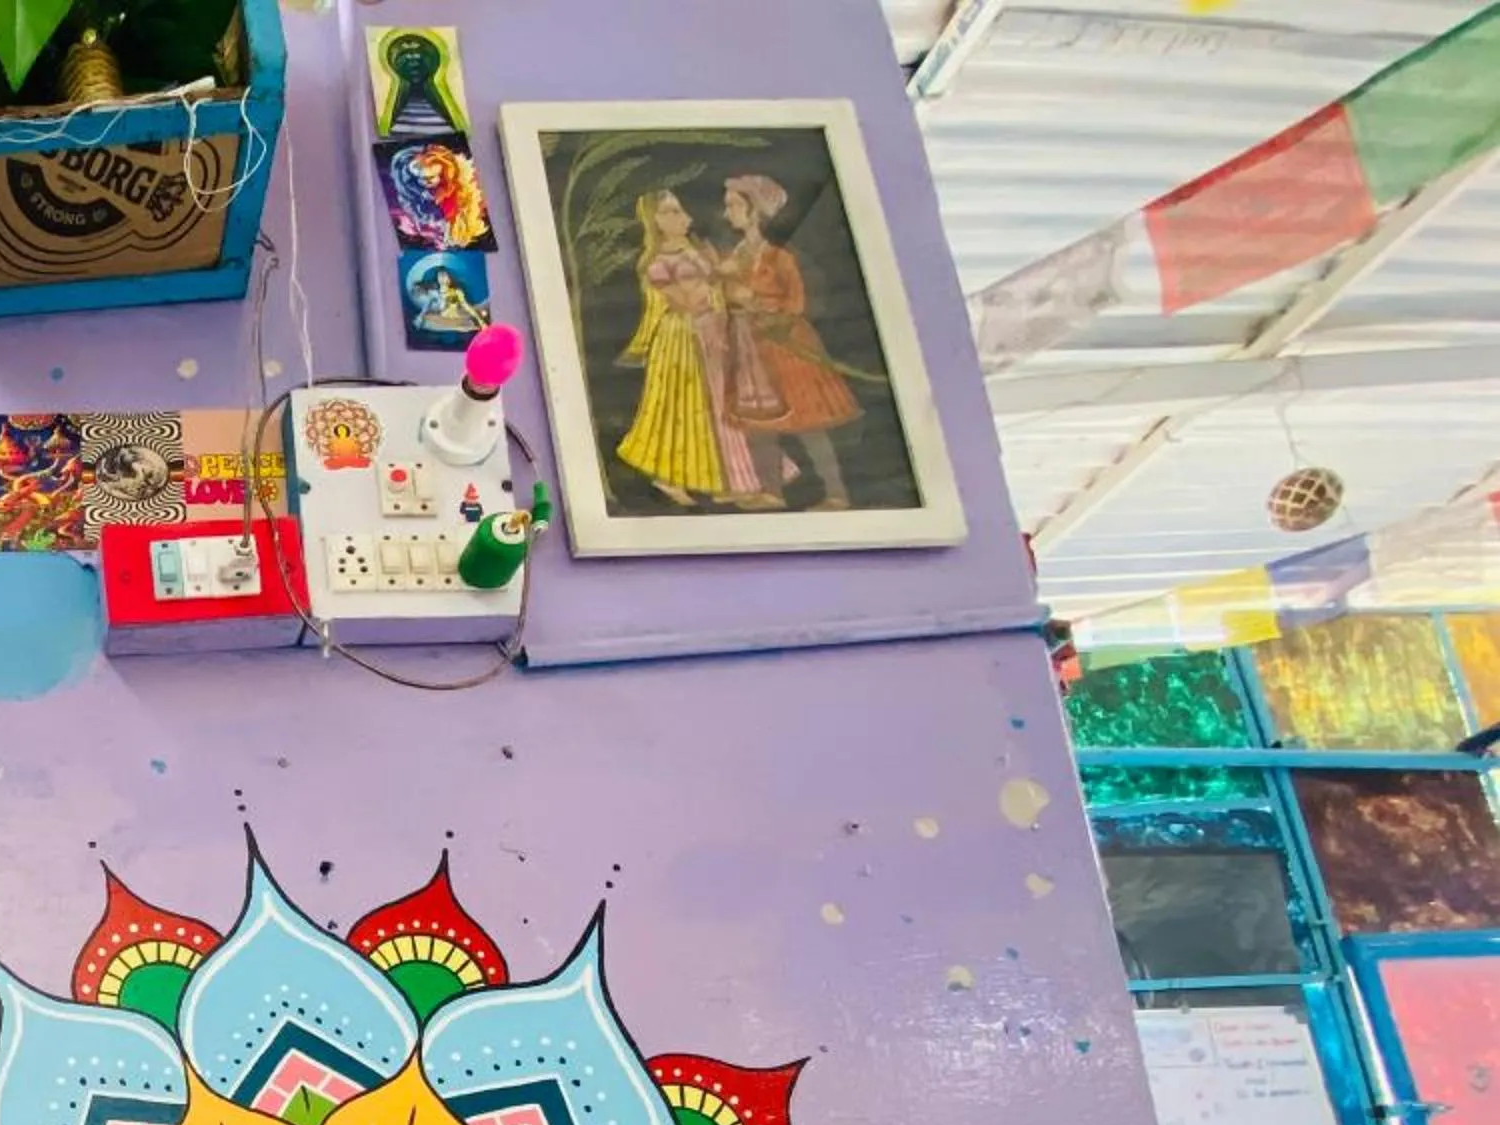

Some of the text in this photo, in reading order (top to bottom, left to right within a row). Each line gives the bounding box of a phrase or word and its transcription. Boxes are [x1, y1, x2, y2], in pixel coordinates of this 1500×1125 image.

[40, 146, 158, 206] BORG
[197, 453, 286, 478] PEACE
[184, 478, 248, 505] LOVE
